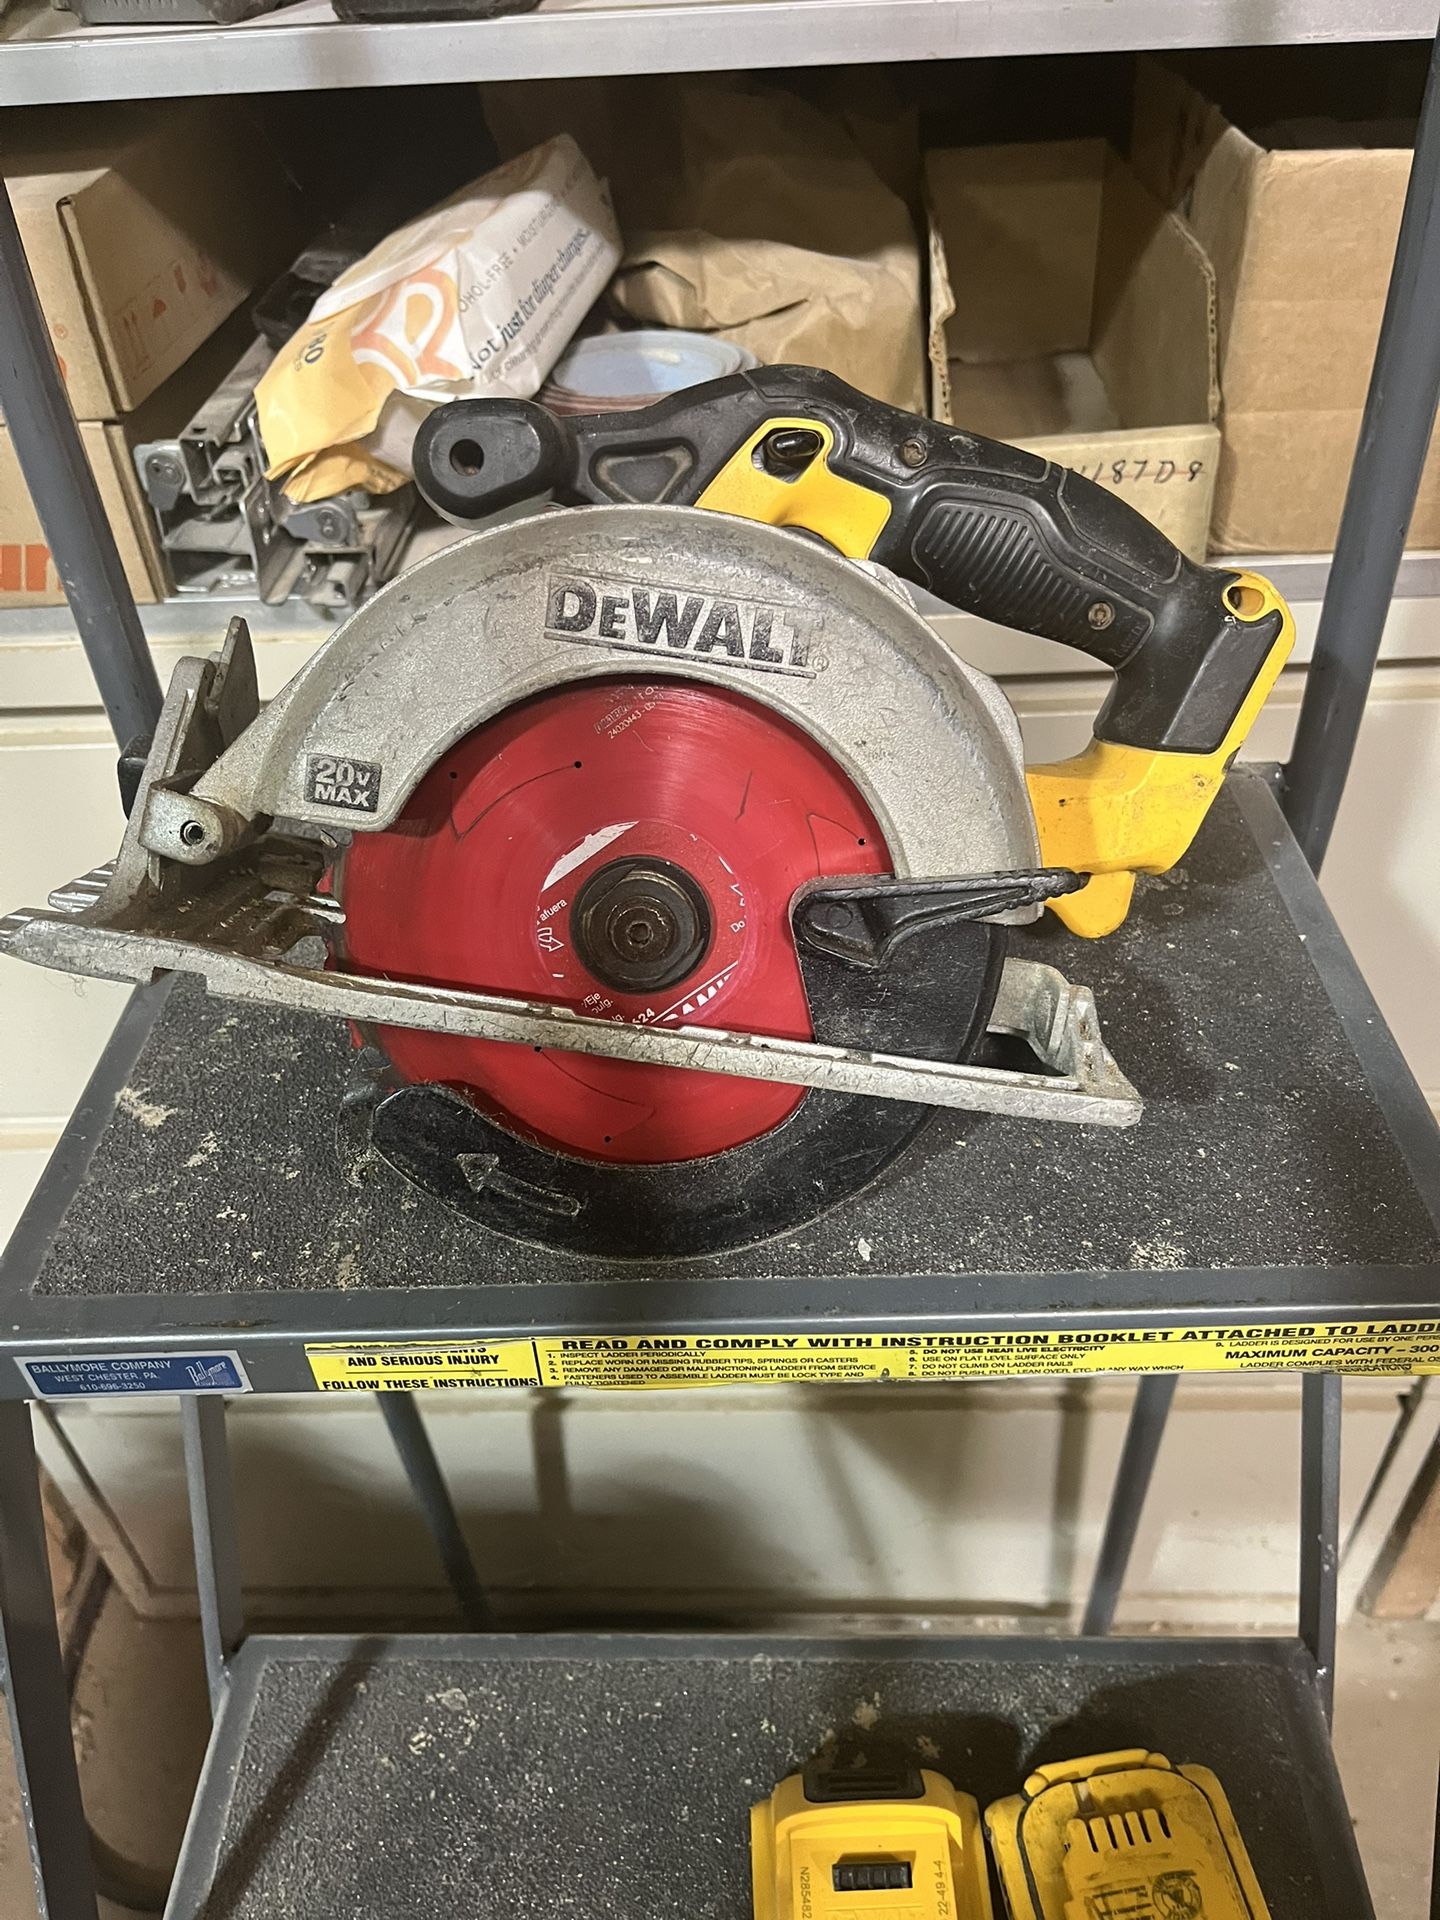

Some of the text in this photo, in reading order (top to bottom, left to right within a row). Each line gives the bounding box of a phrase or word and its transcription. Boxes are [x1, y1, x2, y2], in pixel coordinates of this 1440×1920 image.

[497, 311, 525, 349] just
[520, 294, 537, 321] for
[532, 268, 562, 305] diaper
[315, 759, 371, 787] 20V
[314, 783, 371, 807] MAX
[539, 898, 568, 922] afuera
[581, 992, 601, 1008] /Eje
[562, 1322, 1440, 1350] READ AND COMPLY WITH INSTRUCTION BOOKLET ATTACHED TO LADD
[1225, 1349, 1308, 1359] MAXIMUM
[1311, 1346, 1395, 1356] CAPACITY
[1409, 1344, 1440, 1354] 300
[31, 1362, 108, 1374] BALLYMORE
[111, 1360, 171, 1371] COMPANY
[347, 1354, 499, 1367] AND SERIOUS INJURY
[1239, 1360, 1284, 1368] LADDER
[1286, 1359, 1342, 1367] COMPLIES
[54, 1374, 86, 1383] WEST
[322, 1377, 537, 1390] FOLLOW THESE INSTRUCTIONS
[79, 1382, 146, 1391] 610-696-3250
[799, 1866, 812, 1919] N285482
